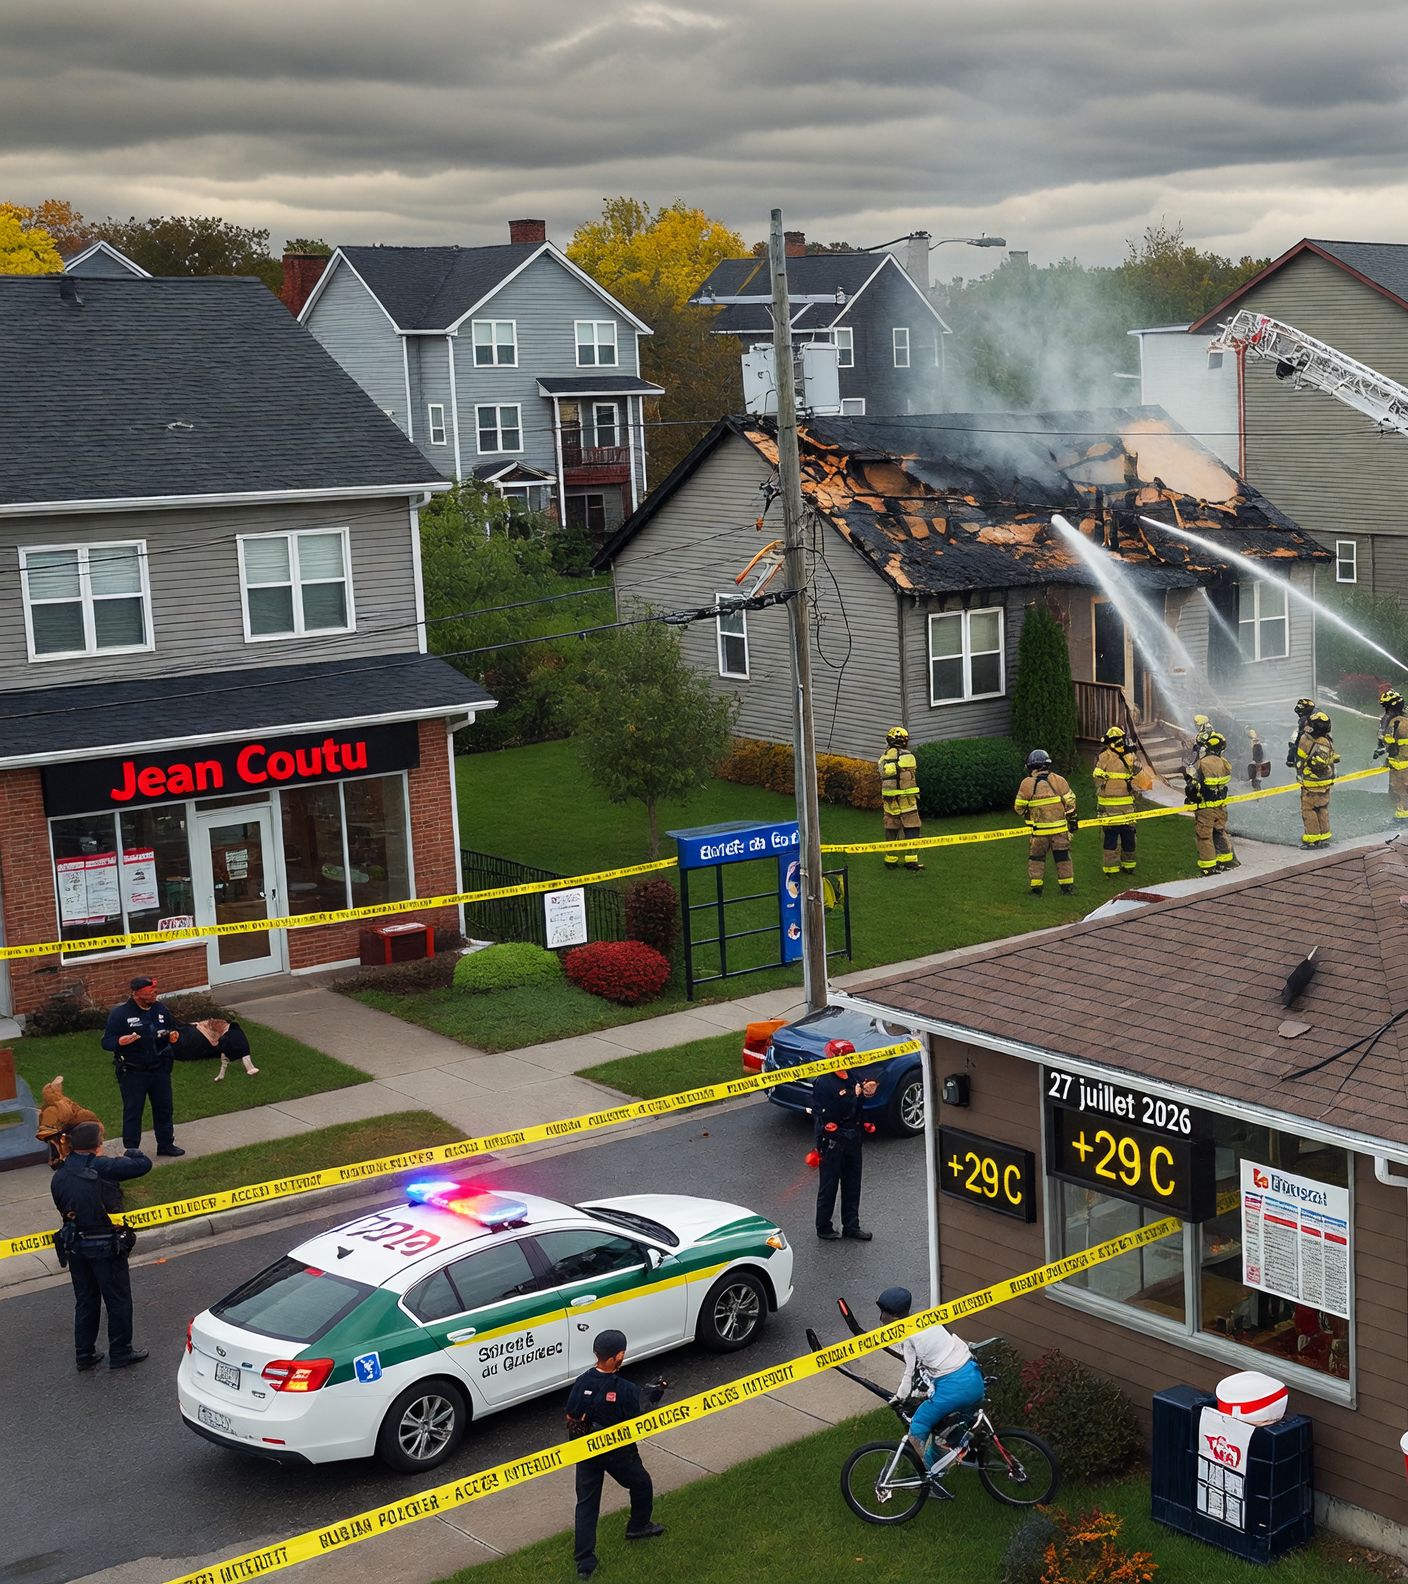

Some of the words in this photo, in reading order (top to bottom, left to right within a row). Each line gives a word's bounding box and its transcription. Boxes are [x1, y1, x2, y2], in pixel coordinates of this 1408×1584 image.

[110, 760, 224, 801] Jean
[236, 738, 368, 784] Coutu
[1048, 1071, 1073, 1100] 27
[1079, 1078, 1136, 1119] juillet
[1142, 1097, 1192, 1135] 2026
[481, 1363, 498, 1379] du
